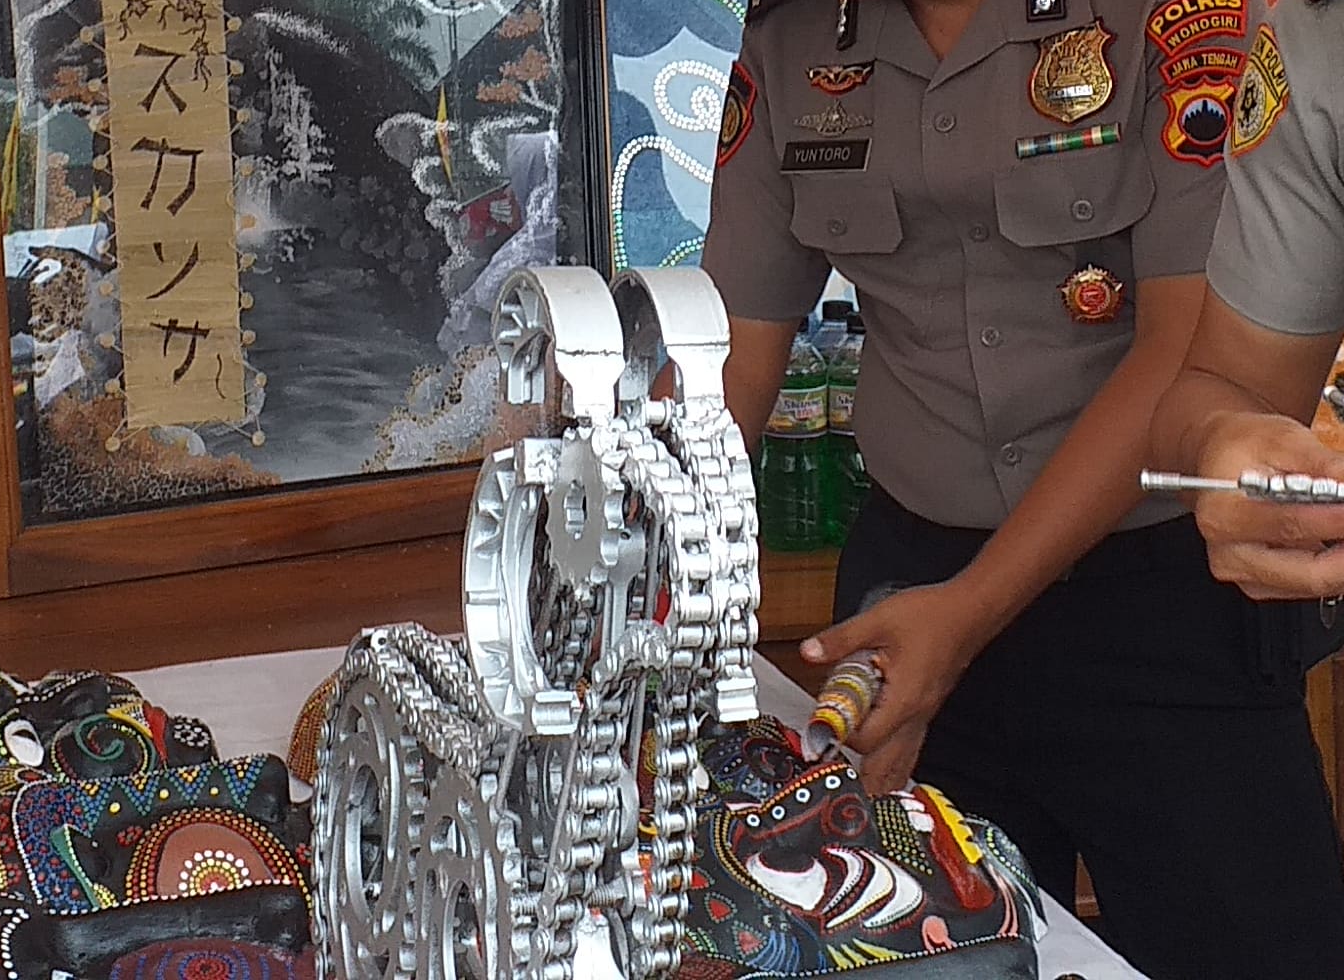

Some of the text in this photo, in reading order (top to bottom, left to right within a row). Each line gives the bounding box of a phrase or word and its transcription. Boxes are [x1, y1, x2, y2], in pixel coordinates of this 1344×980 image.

[1167, 15, 1238, 48] WONOGIRI
[1171, 53, 1238, 77] JAWA TENGAH
[795, 146, 851, 163] YUNTORO
